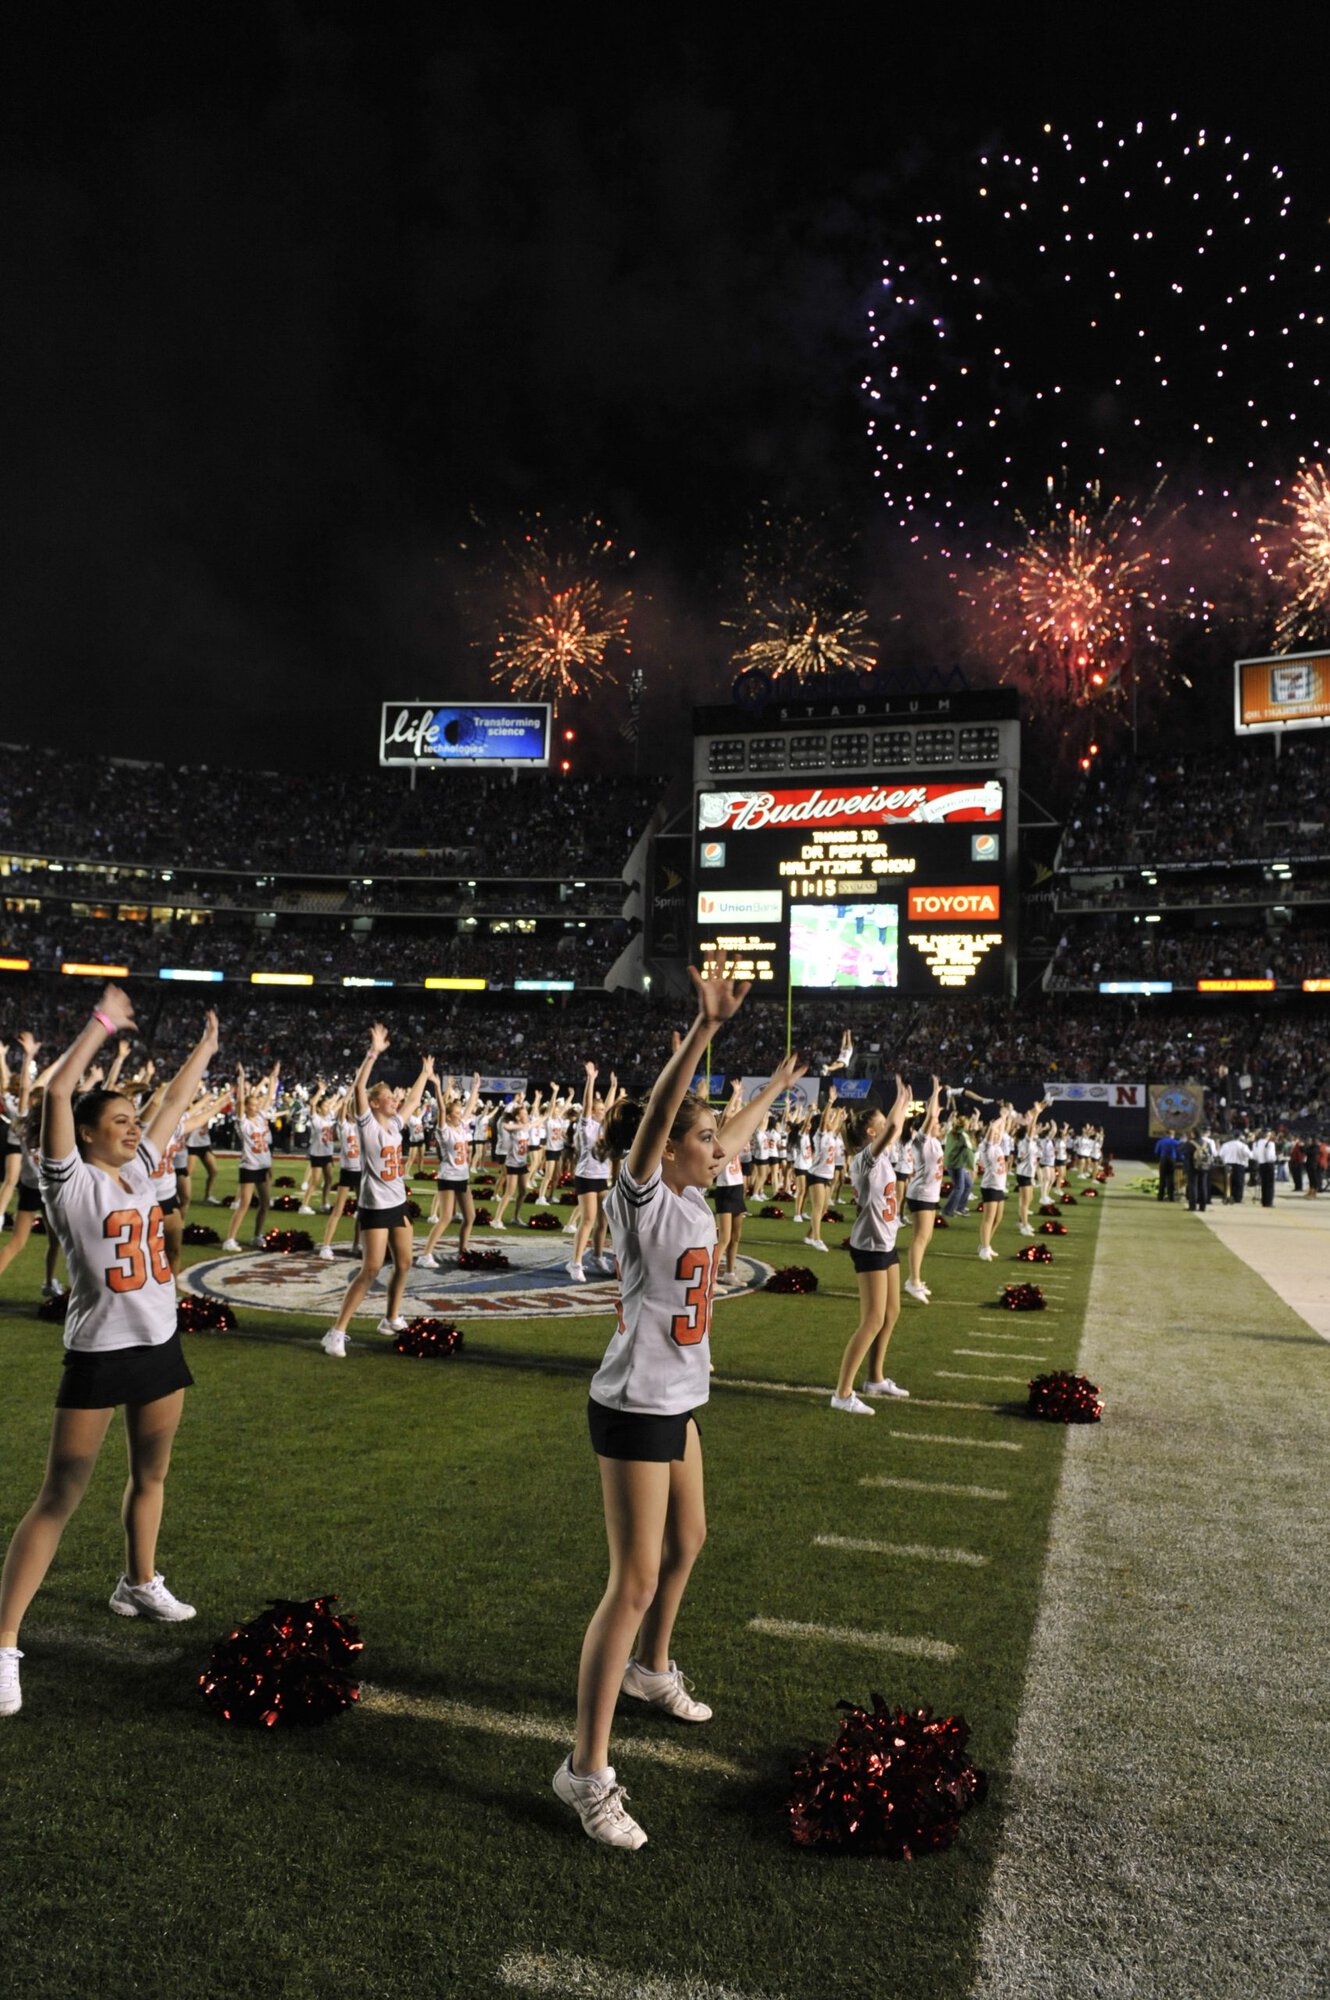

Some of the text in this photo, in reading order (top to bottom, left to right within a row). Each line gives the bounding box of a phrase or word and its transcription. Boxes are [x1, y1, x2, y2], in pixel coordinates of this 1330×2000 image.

[780, 699, 951, 718] STADIUM
[473, 717, 541, 729] Transforming
[385, 709, 440, 757] life
[488, 727, 526, 737] science
[423, 744, 486, 755] technologies
[727, 786, 927, 831] Budweiser
[861, 830, 879, 842] TO
[802, 843, 888, 859] DR PEPPER
[779, 858, 916, 875] HALFTIME SHOW
[790, 880, 837, 896] 11:15
[654, 895, 687, 910] Sprint
[912, 895, 995, 912] TOYOTA
[1116, 1086, 1137, 1105] N
